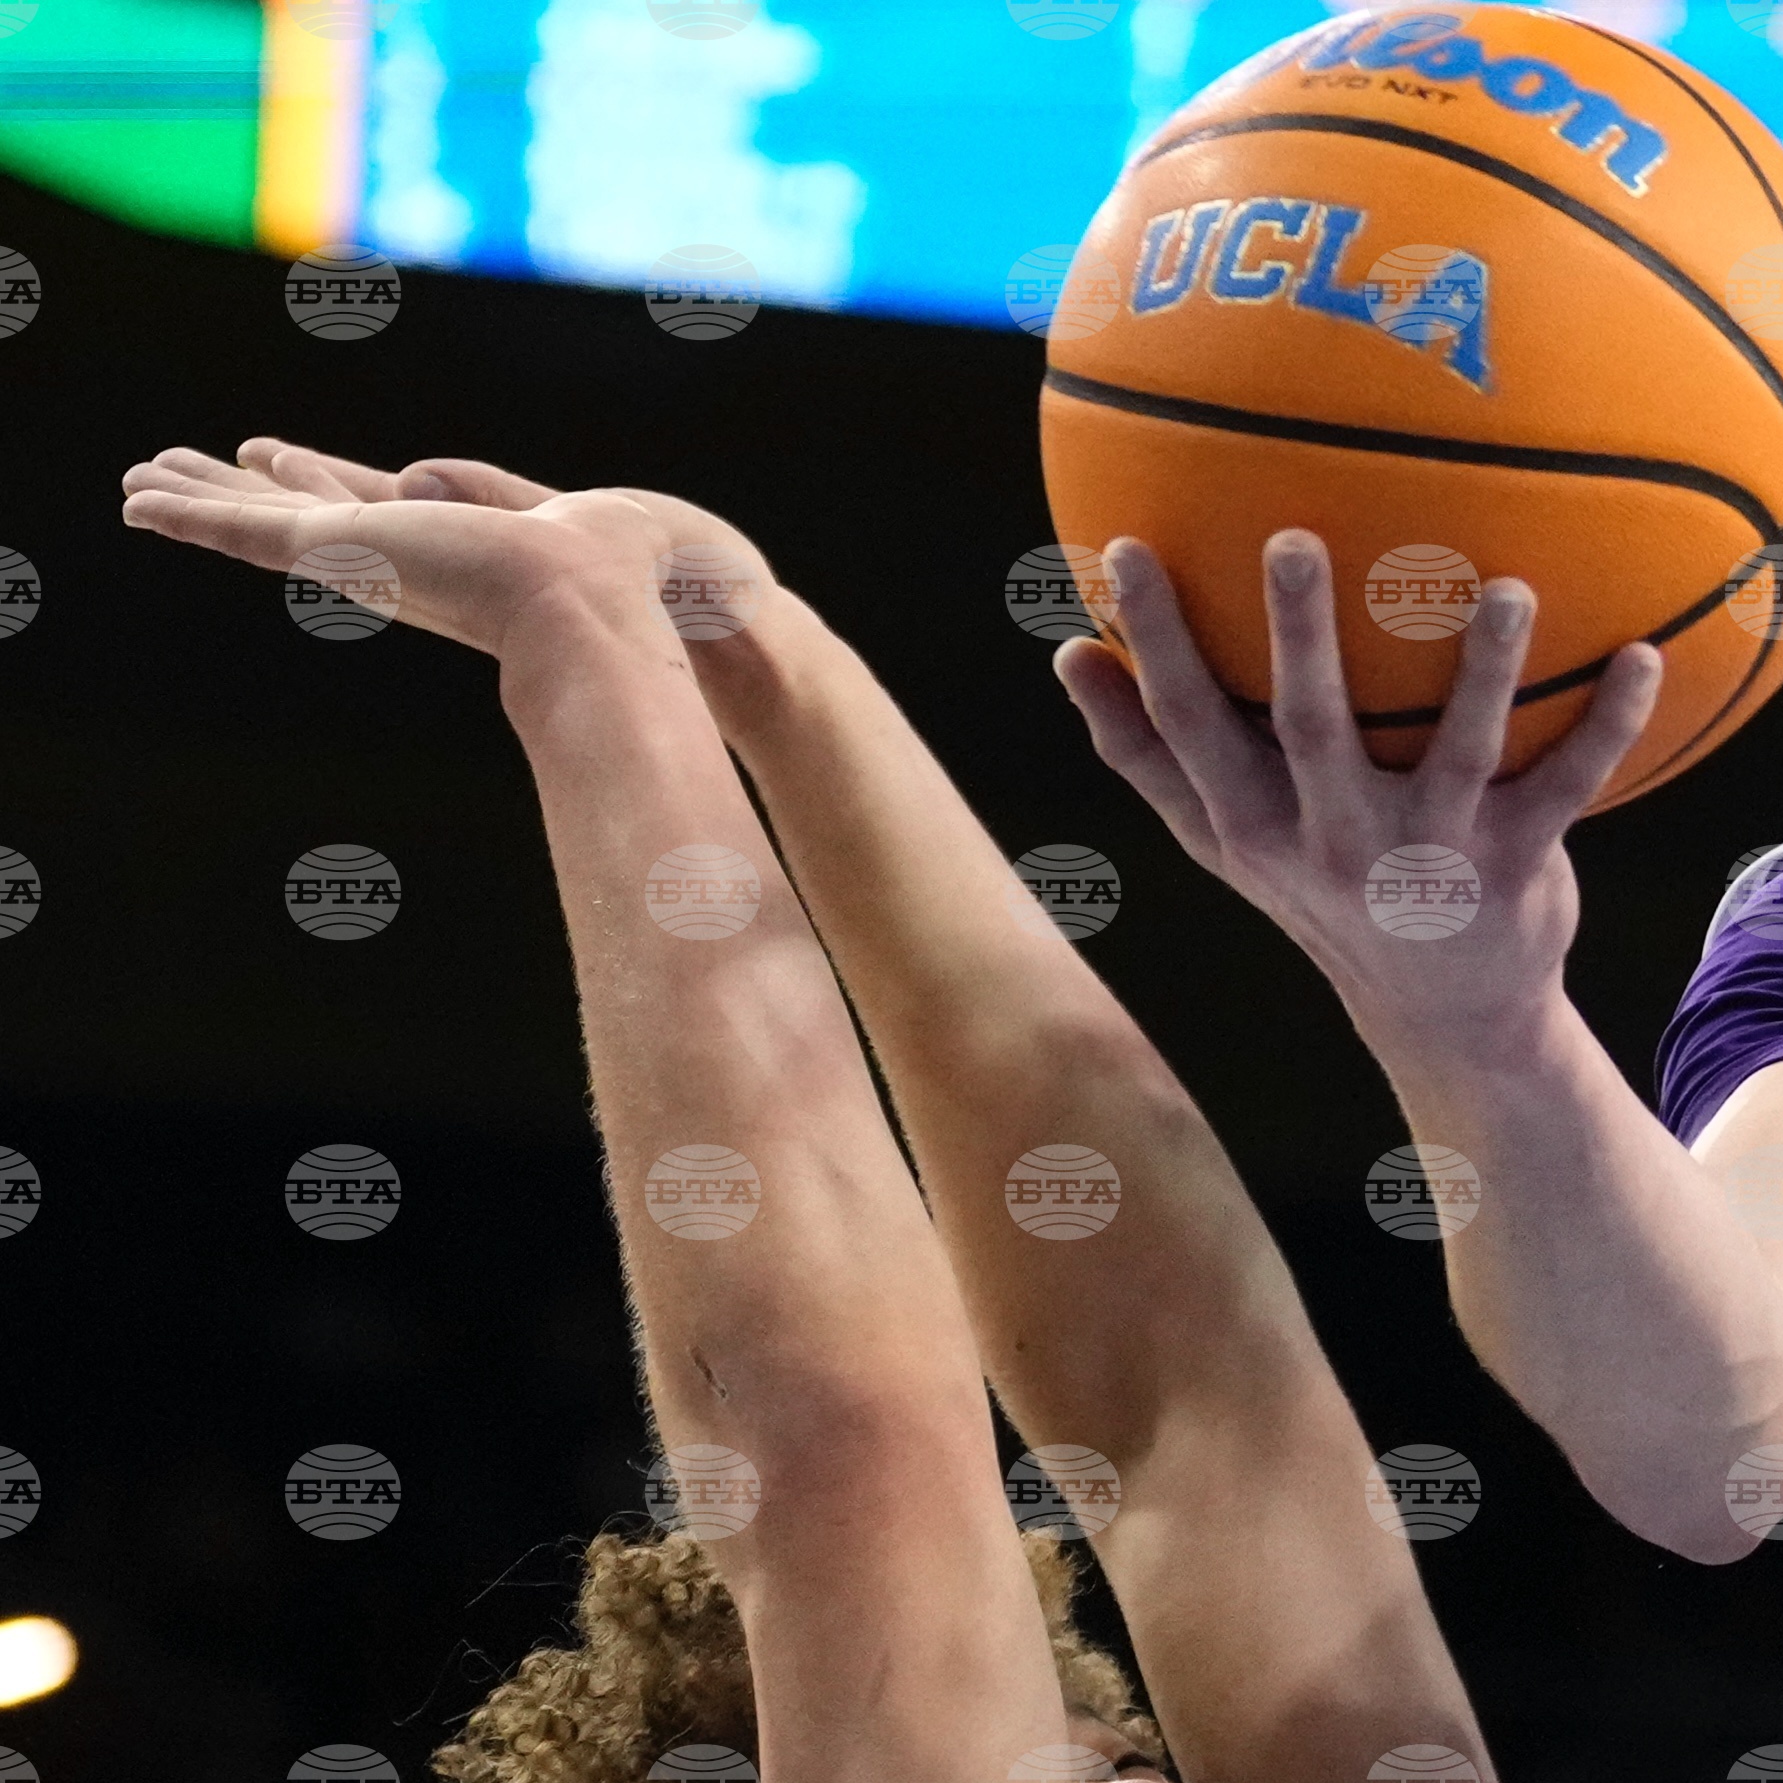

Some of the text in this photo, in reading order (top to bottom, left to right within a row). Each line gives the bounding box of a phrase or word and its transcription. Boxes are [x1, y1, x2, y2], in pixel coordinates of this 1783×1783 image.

[1280, 12, 1668, 198] ilson
[1382, 78, 1459, 106] NXT
[1126, 196, 1493, 396] UCLA
